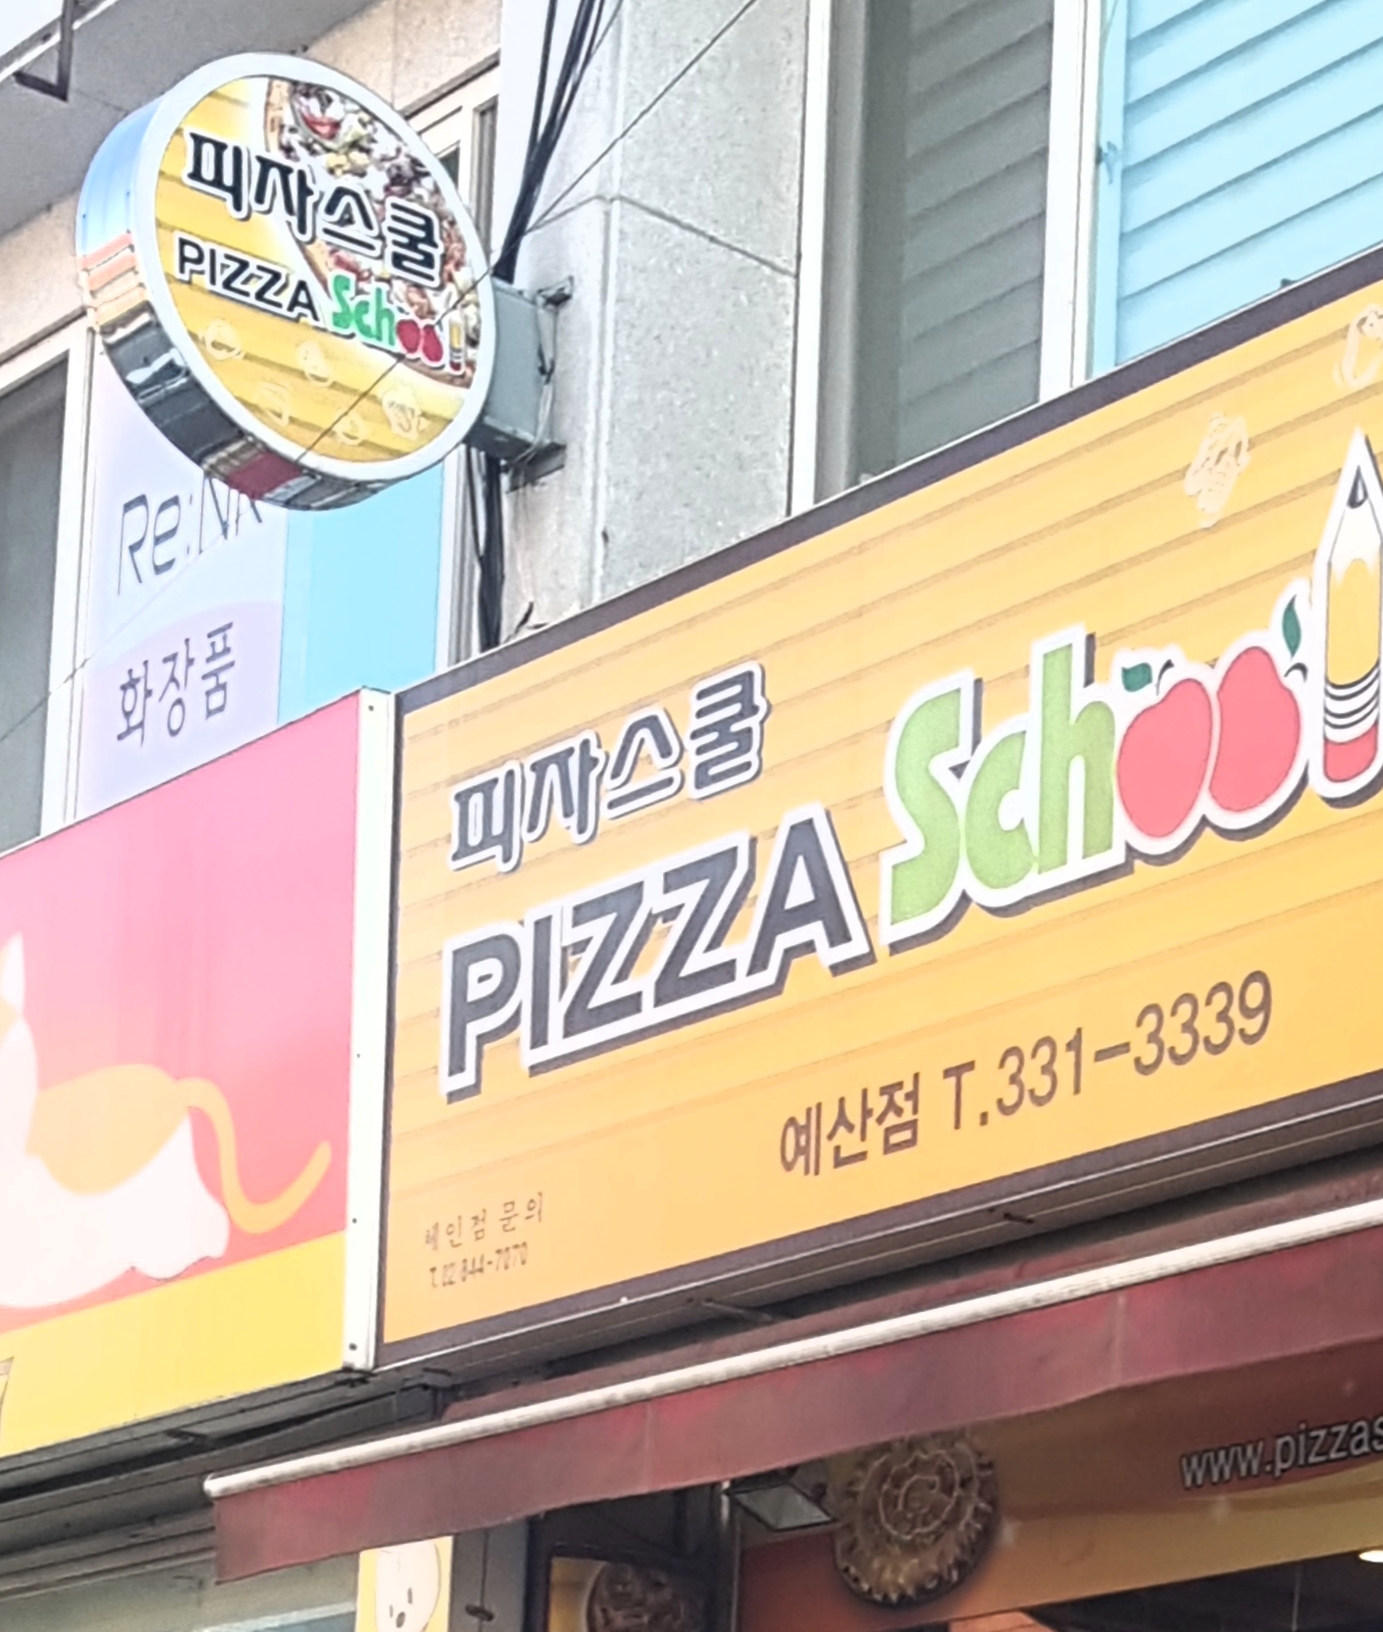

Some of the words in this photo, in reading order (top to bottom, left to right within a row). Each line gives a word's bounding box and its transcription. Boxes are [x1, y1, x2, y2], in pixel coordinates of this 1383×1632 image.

[187, 130, 442, 286] 피자스쿨
[177, 236, 320, 322] PIZZA
[116, 621, 236, 747] 화장품
[455, 671, 764, 866] 피자스쿨
[446, 814, 857, 1079] PIZZA
[779, 1072, 920, 1178] 예산점
[499, 1191, 543, 1233] 문의
